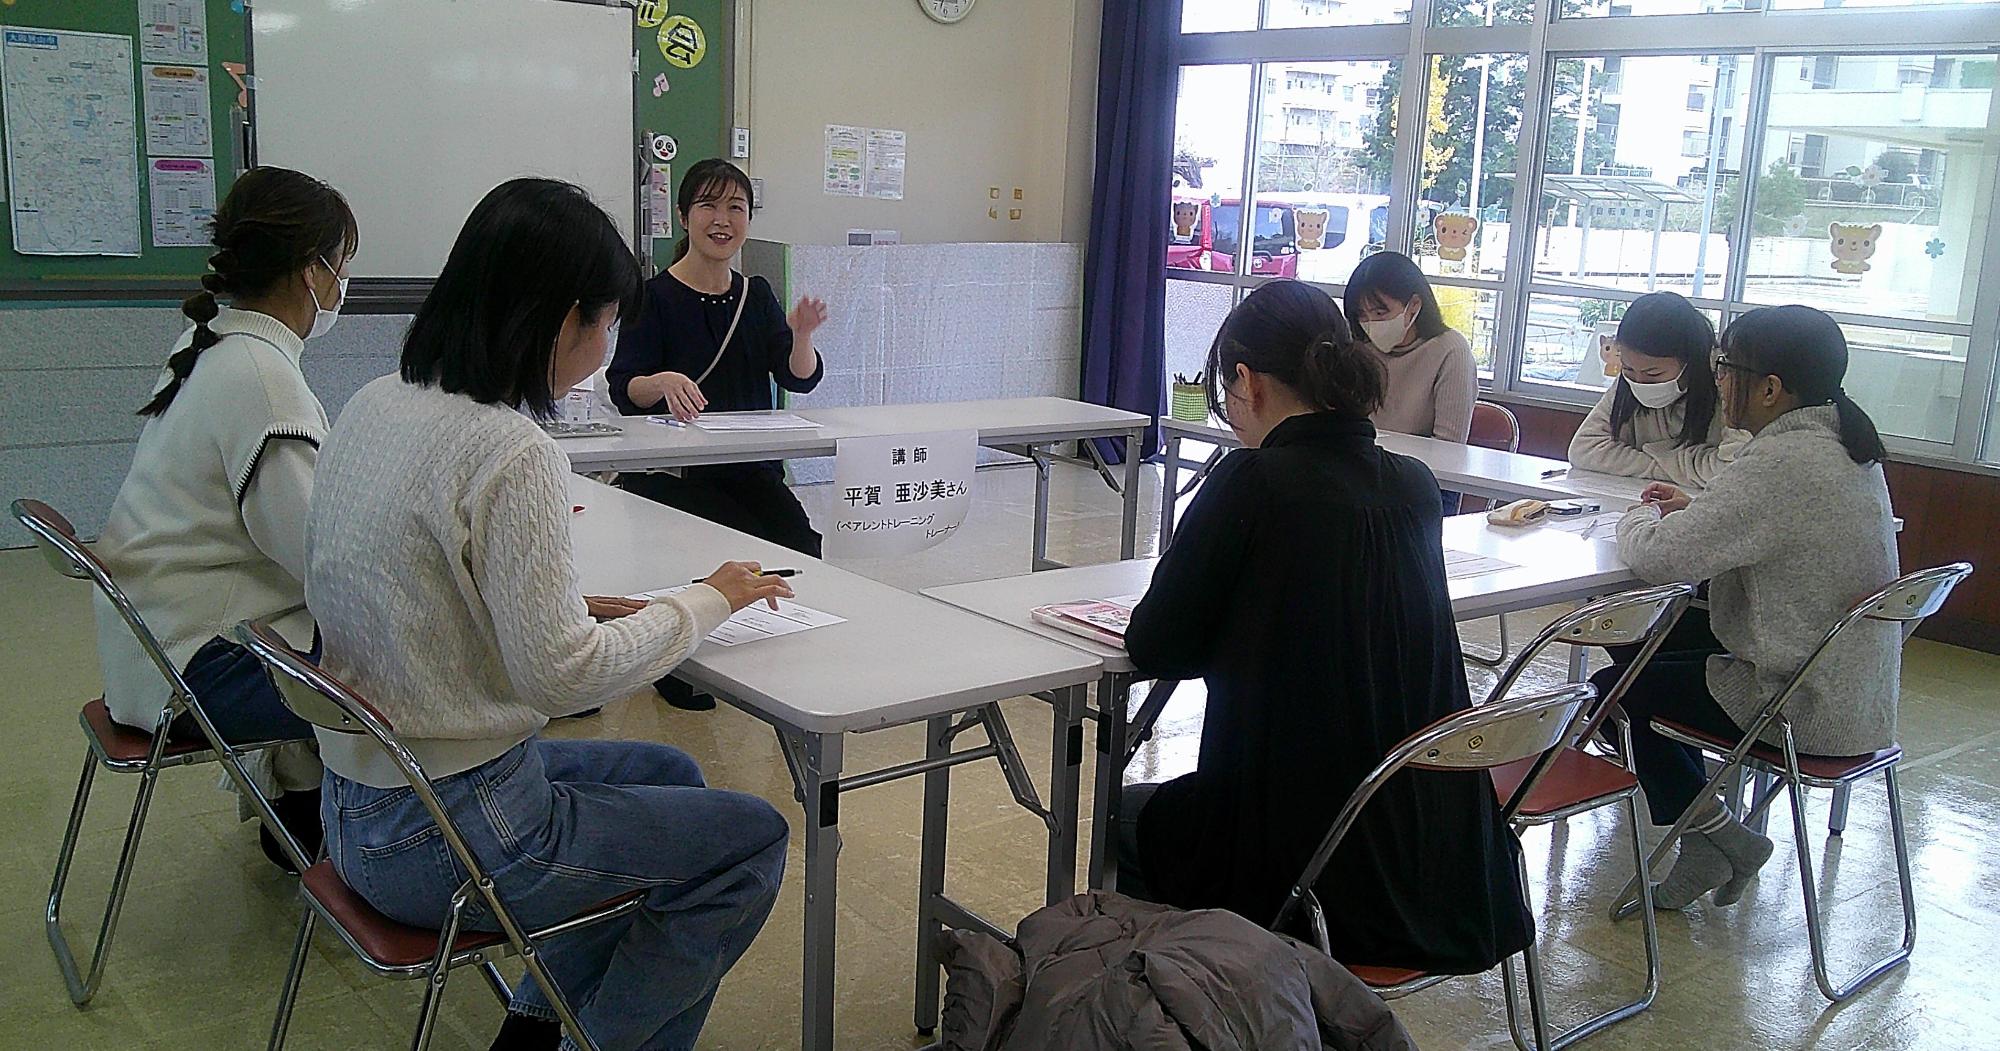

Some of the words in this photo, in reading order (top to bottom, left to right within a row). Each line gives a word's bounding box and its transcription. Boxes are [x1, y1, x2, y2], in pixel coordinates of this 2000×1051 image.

[844, 485, 882, 507] 平賀
[895, 479, 968, 503] 亜沙美さん
